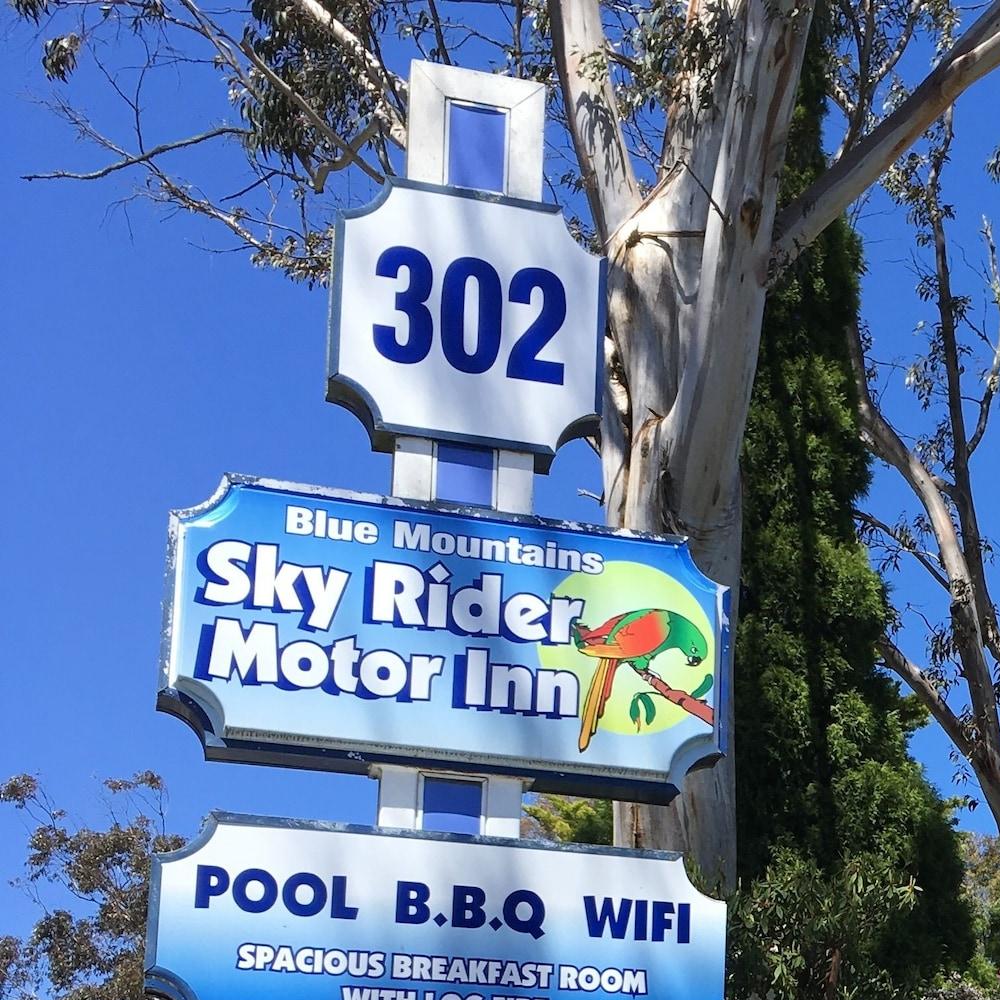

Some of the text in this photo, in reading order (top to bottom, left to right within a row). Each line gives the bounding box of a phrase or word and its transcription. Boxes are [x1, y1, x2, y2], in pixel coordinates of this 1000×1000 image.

[372, 246, 567, 386] 302
[285, 505, 605, 576] Blue Mountains
[195, 539, 585, 645] Sky Rider
[195, 618, 580, 719] Motor Inn
[194, 864, 691, 944] POOL B.B.Q WIFI
[236, 943, 647, 996] SPACIOUS BREAKFAST ROOM
